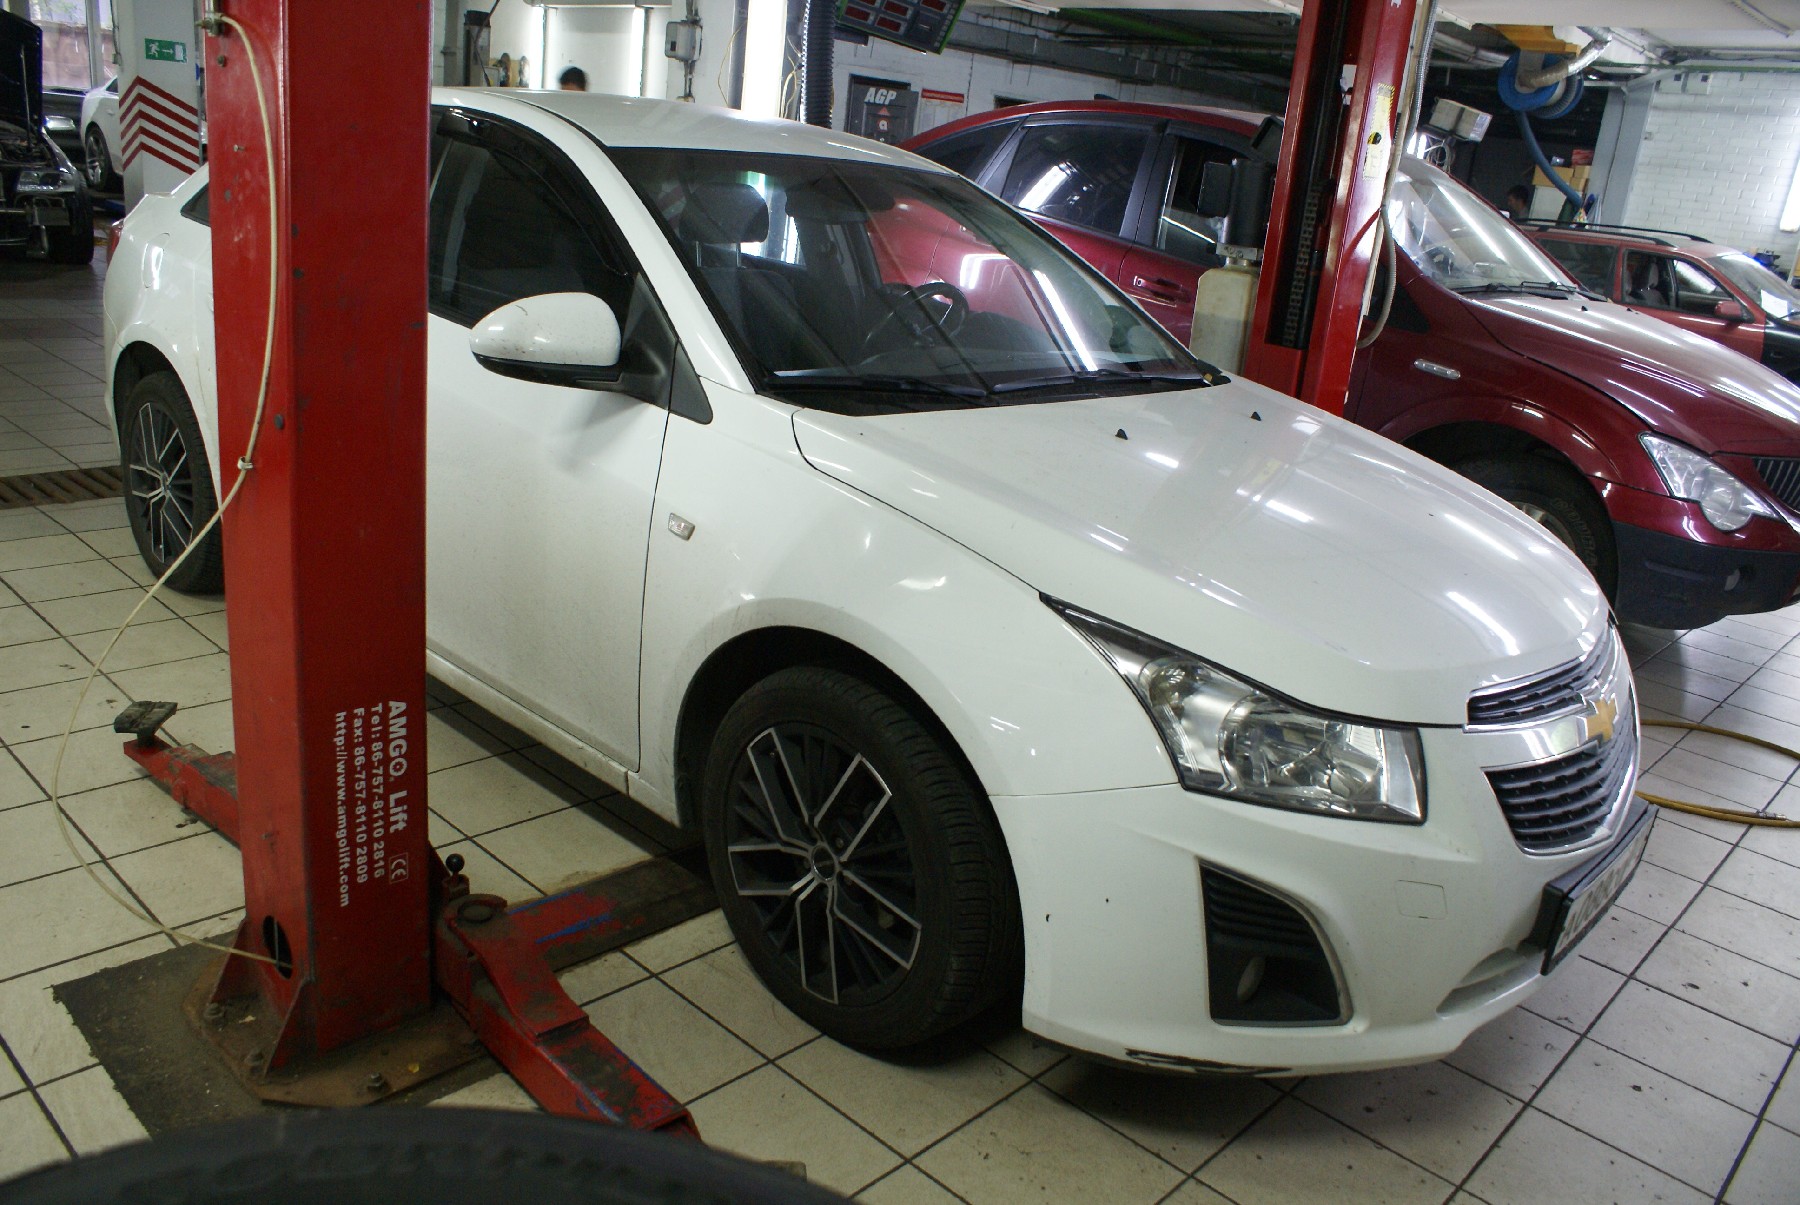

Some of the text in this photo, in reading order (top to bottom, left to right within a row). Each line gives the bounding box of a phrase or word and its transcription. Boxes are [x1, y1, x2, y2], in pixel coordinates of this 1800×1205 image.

[864, 87, 897, 105] AGP
[333, 711, 350, 907] http://www.amgolift.com
[353, 707, 369, 884] Fax: 86-757-8110 2809
[371, 702, 385, 878] Tel: 86-757-8110 2816
[389, 790, 408, 834] Lift
